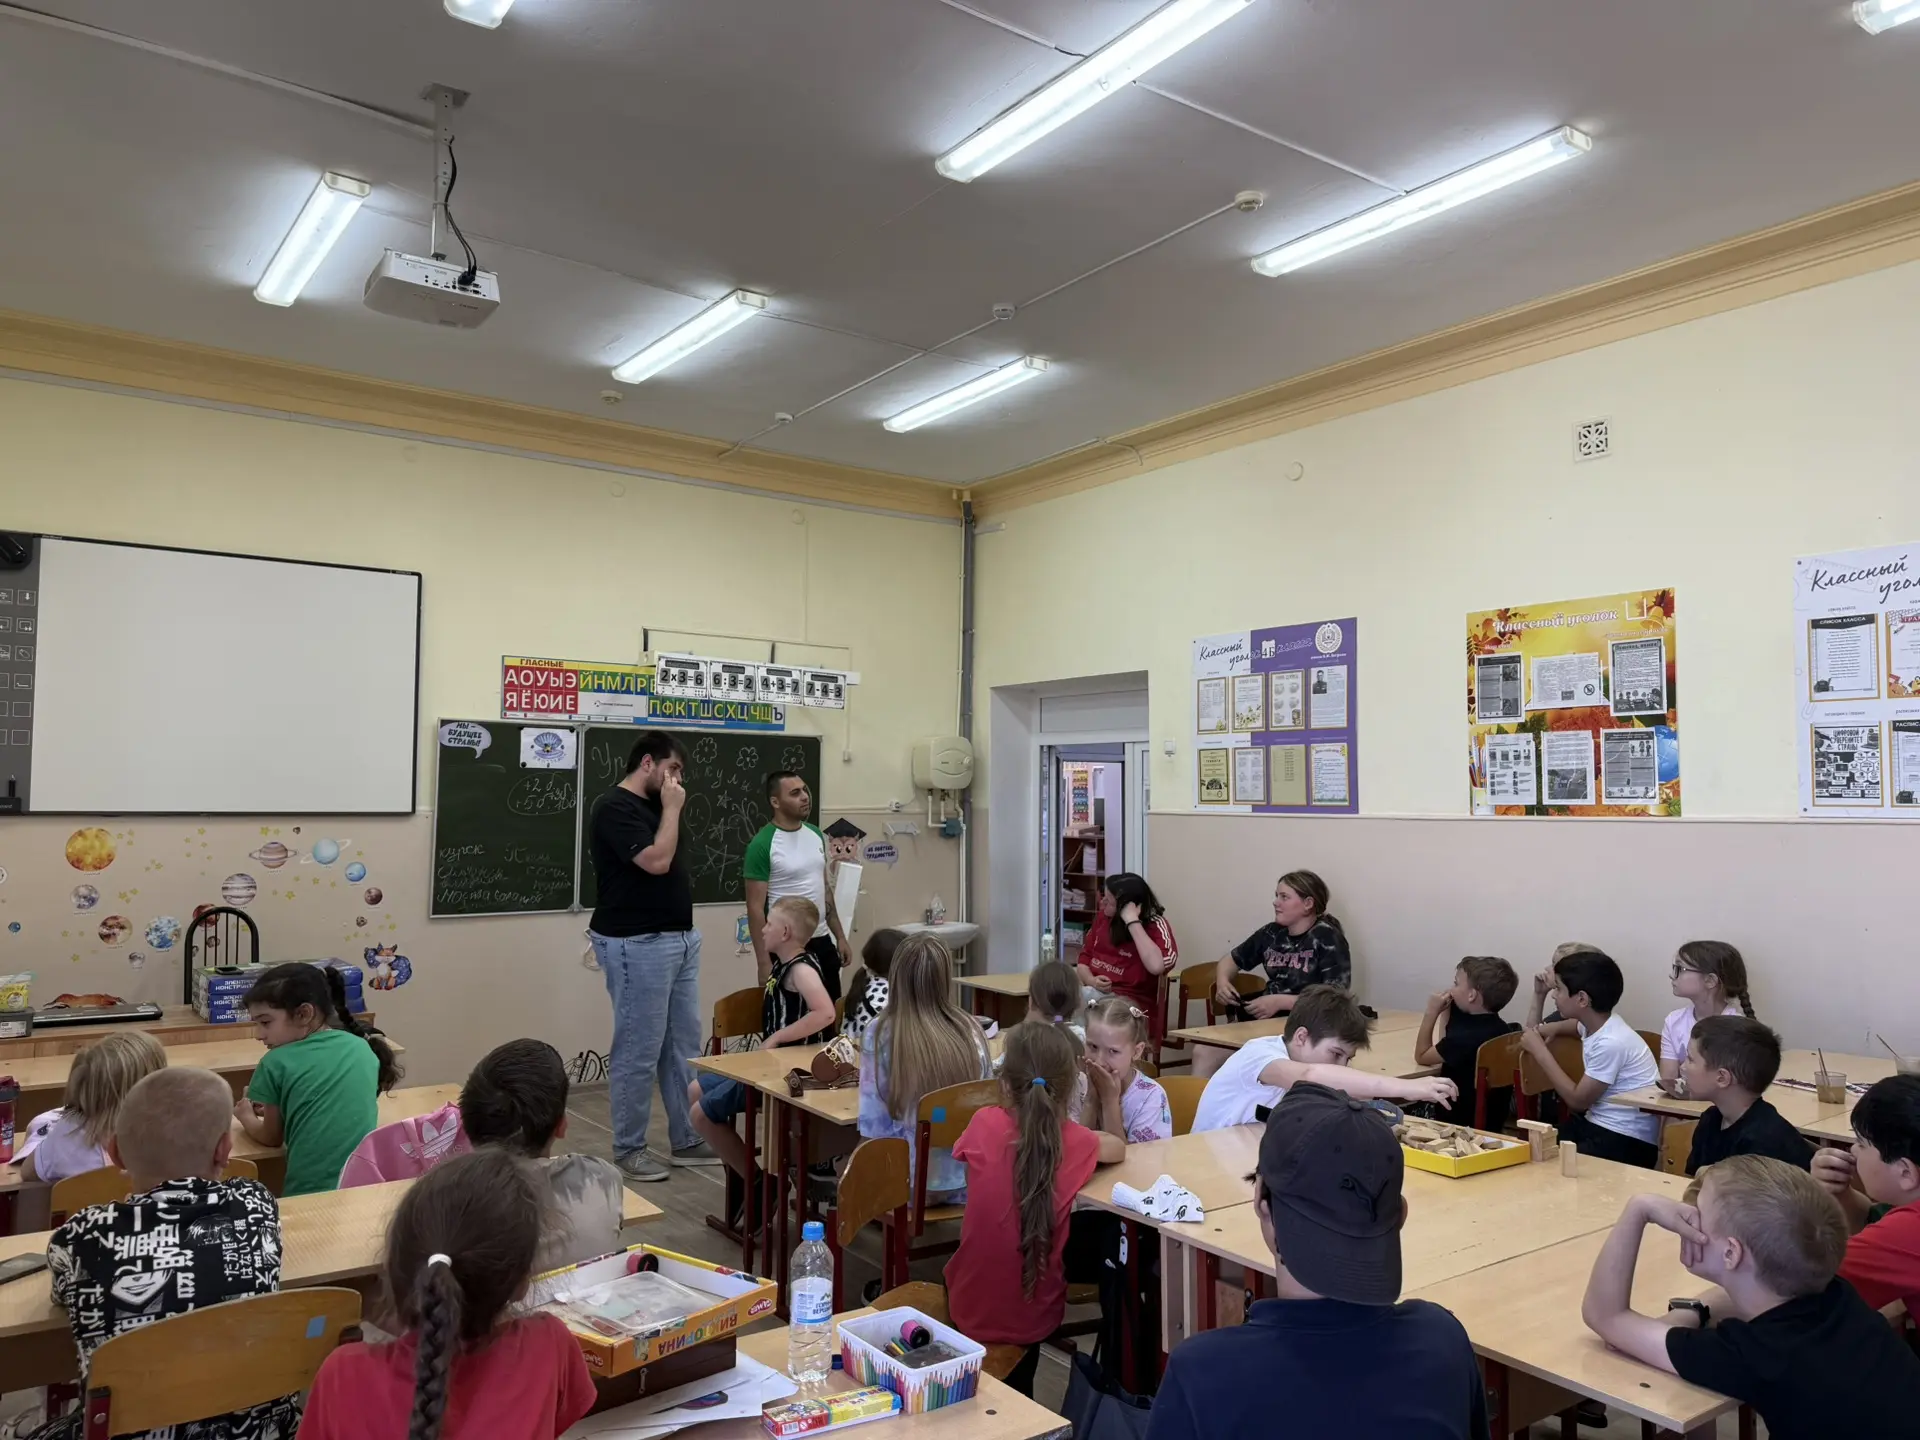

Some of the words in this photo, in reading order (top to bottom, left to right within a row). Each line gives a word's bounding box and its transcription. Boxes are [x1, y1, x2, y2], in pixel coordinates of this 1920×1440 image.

[1811, 554, 1907, 592] Классный
[1493, 613, 1565, 633] Классный
[1567, 608, 1619, 626] уголок
[1199, 638, 1243, 661] Классный
[520, 658, 564, 668] ГЛАСНЫЕ
[448, 729, 482, 738] БУДУЩЕЕ
[1838, 743, 1858, 751] СТРАНЫ
